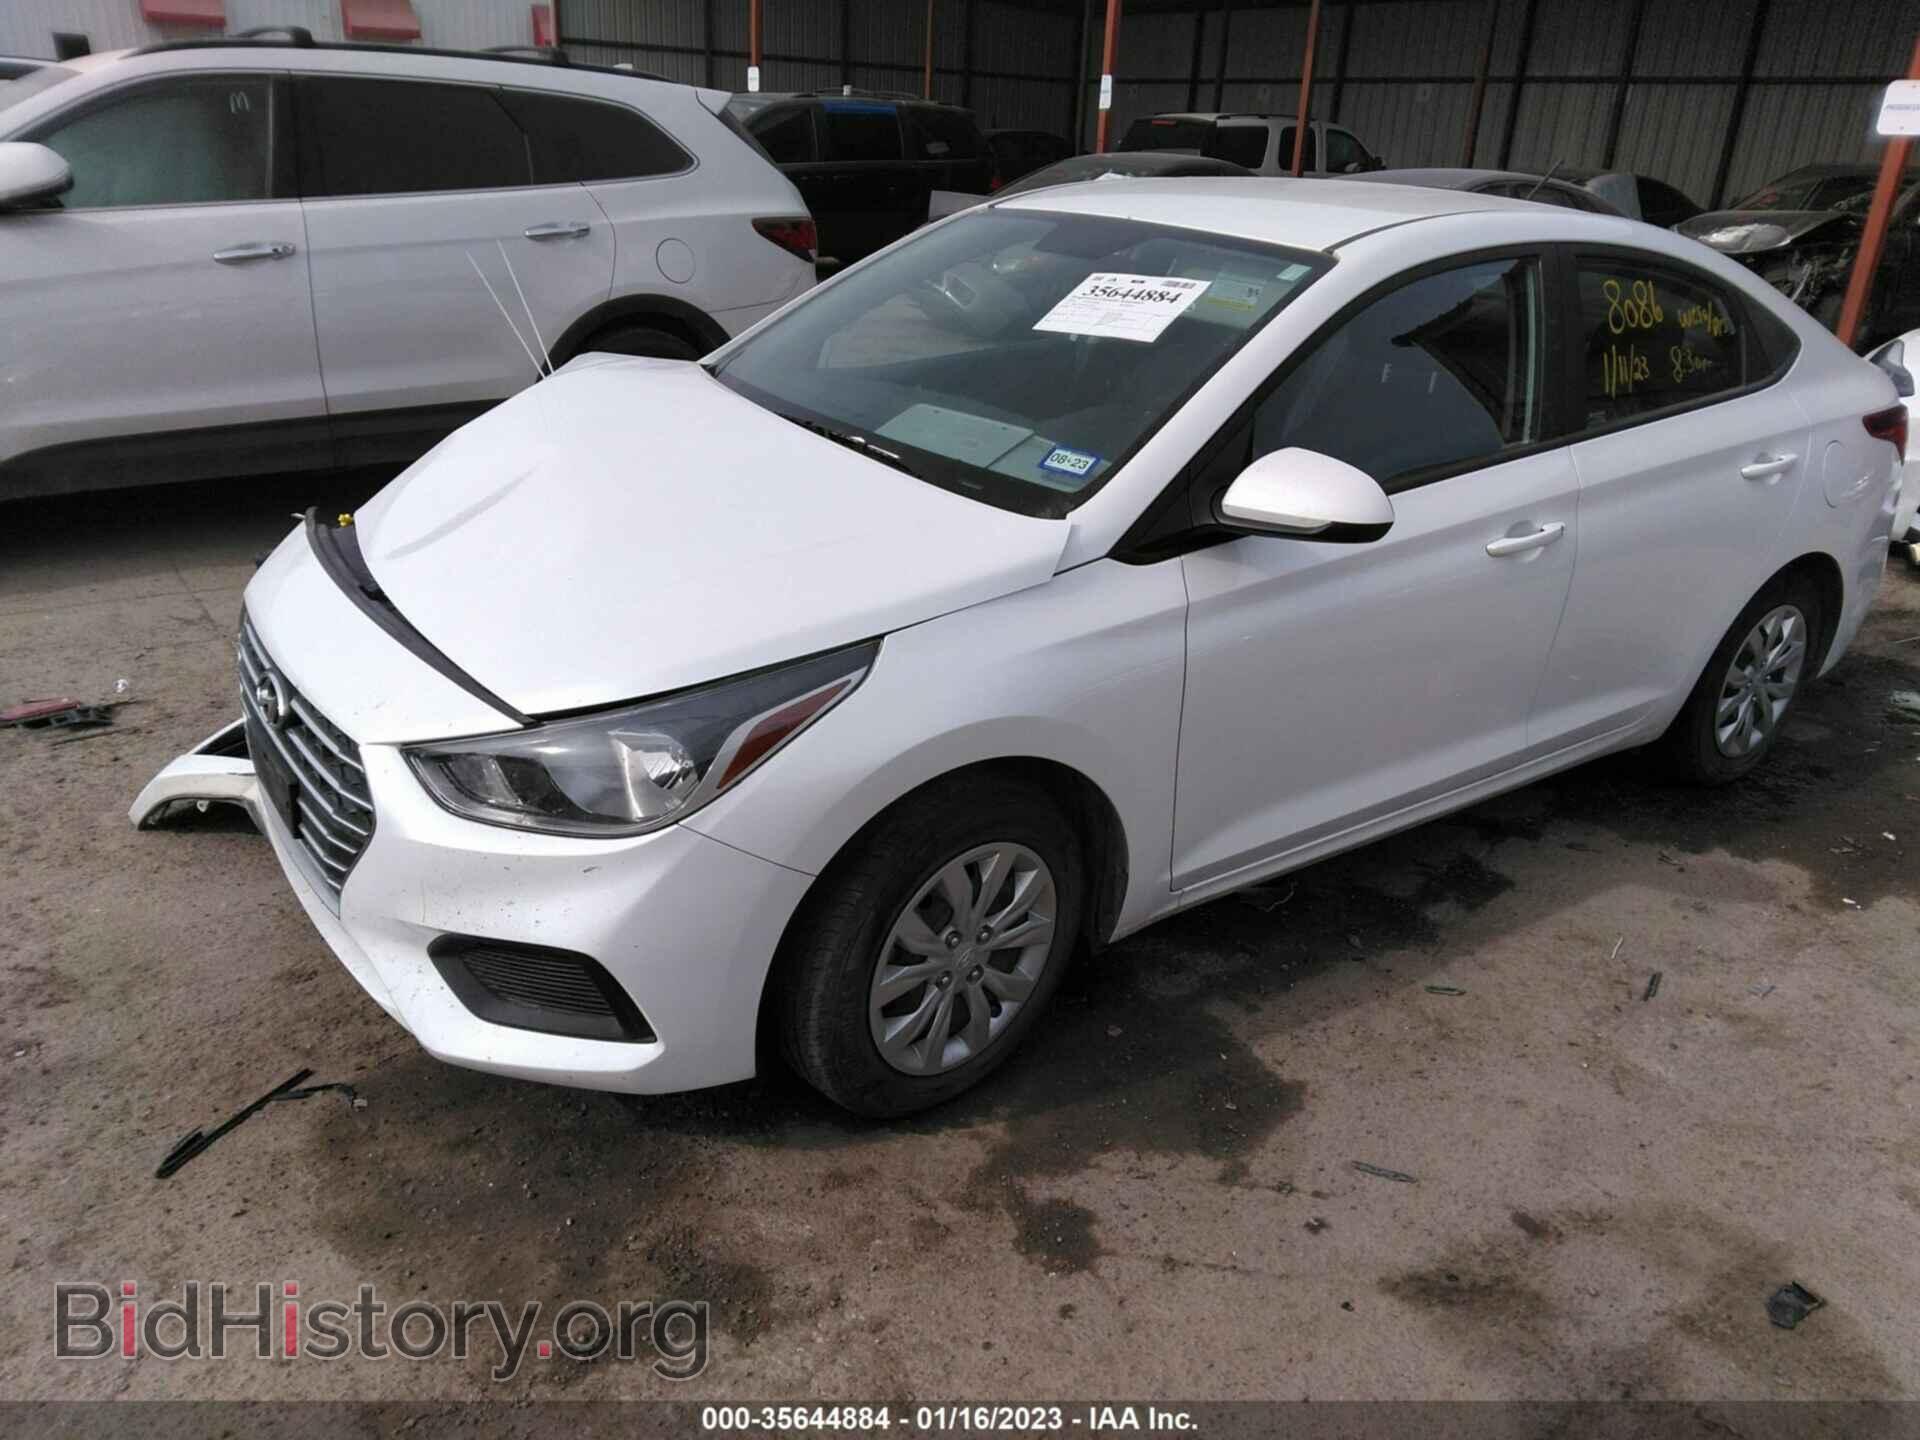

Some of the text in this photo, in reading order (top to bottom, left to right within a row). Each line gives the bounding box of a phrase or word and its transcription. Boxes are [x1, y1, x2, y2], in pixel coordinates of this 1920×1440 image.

[1082, 284, 1182, 304] 35644884
[1603, 279, 1663, 334] 8086
[1603, 344, 1649, 399] 1/11/23
